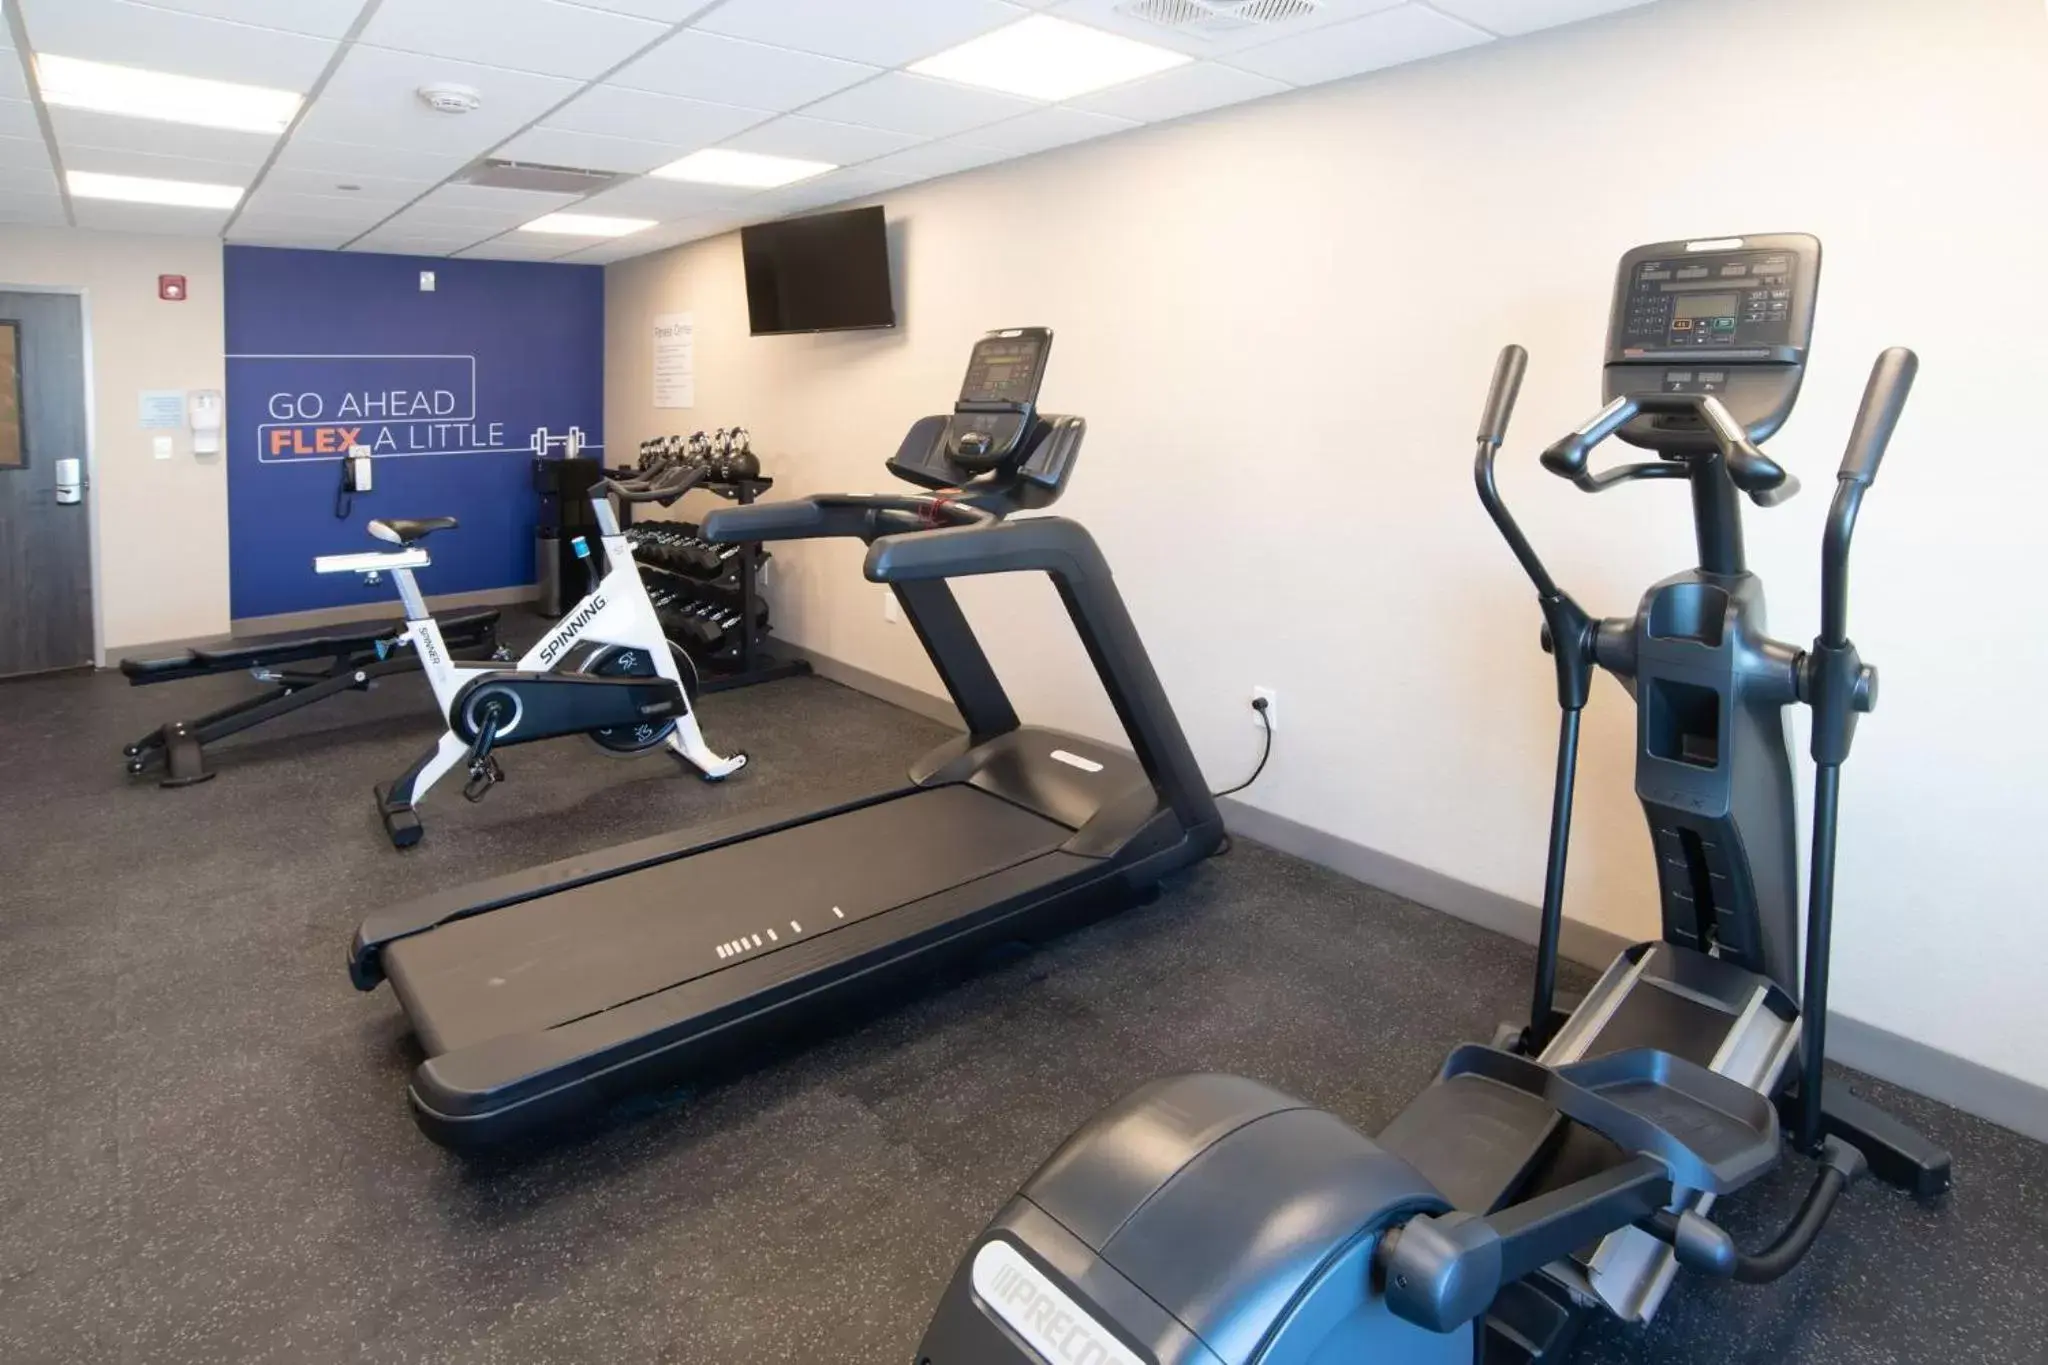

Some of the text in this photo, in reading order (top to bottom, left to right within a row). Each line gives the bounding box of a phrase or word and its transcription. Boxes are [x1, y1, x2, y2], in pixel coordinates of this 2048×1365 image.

[268, 390, 456, 420] GO AHEAD
[270, 422, 504, 455] FLEX A LITTLE
[539, 594, 607, 665] SPINNING
[1005, 1276, 1124, 1365] PRECO
